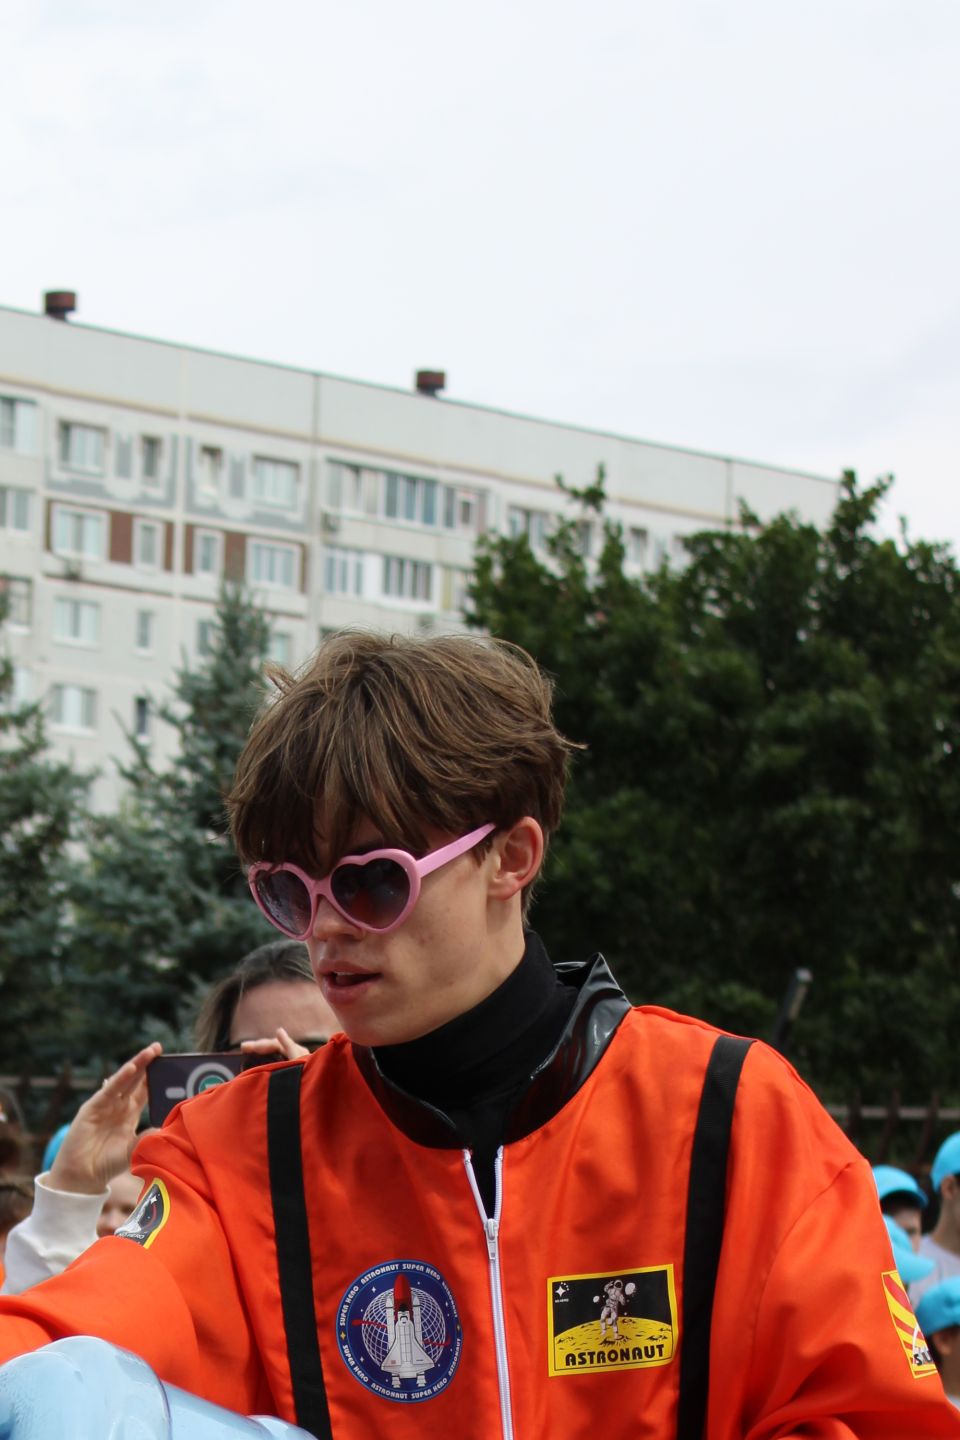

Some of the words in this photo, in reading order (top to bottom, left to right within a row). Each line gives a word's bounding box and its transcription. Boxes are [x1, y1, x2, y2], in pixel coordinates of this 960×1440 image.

[340, 1304, 351, 1326] SUPER
[346, 1285, 359, 1305] HERO
[361, 1263, 399, 1284] ASTRONAUT
[402, 1263, 424, 1272] SUPER
[425, 1266, 441, 1281] HERO
[342, 1345, 355, 1367] SUPER
[353, 1366, 369, 1383] HERO
[371, 1382, 408, 1399] ASTRONAUT
[411, 1388, 432, 1399] SUPER
[433, 1377, 448, 1392] HERO
[565, 1344, 665, 1366] ASTRONAUT
